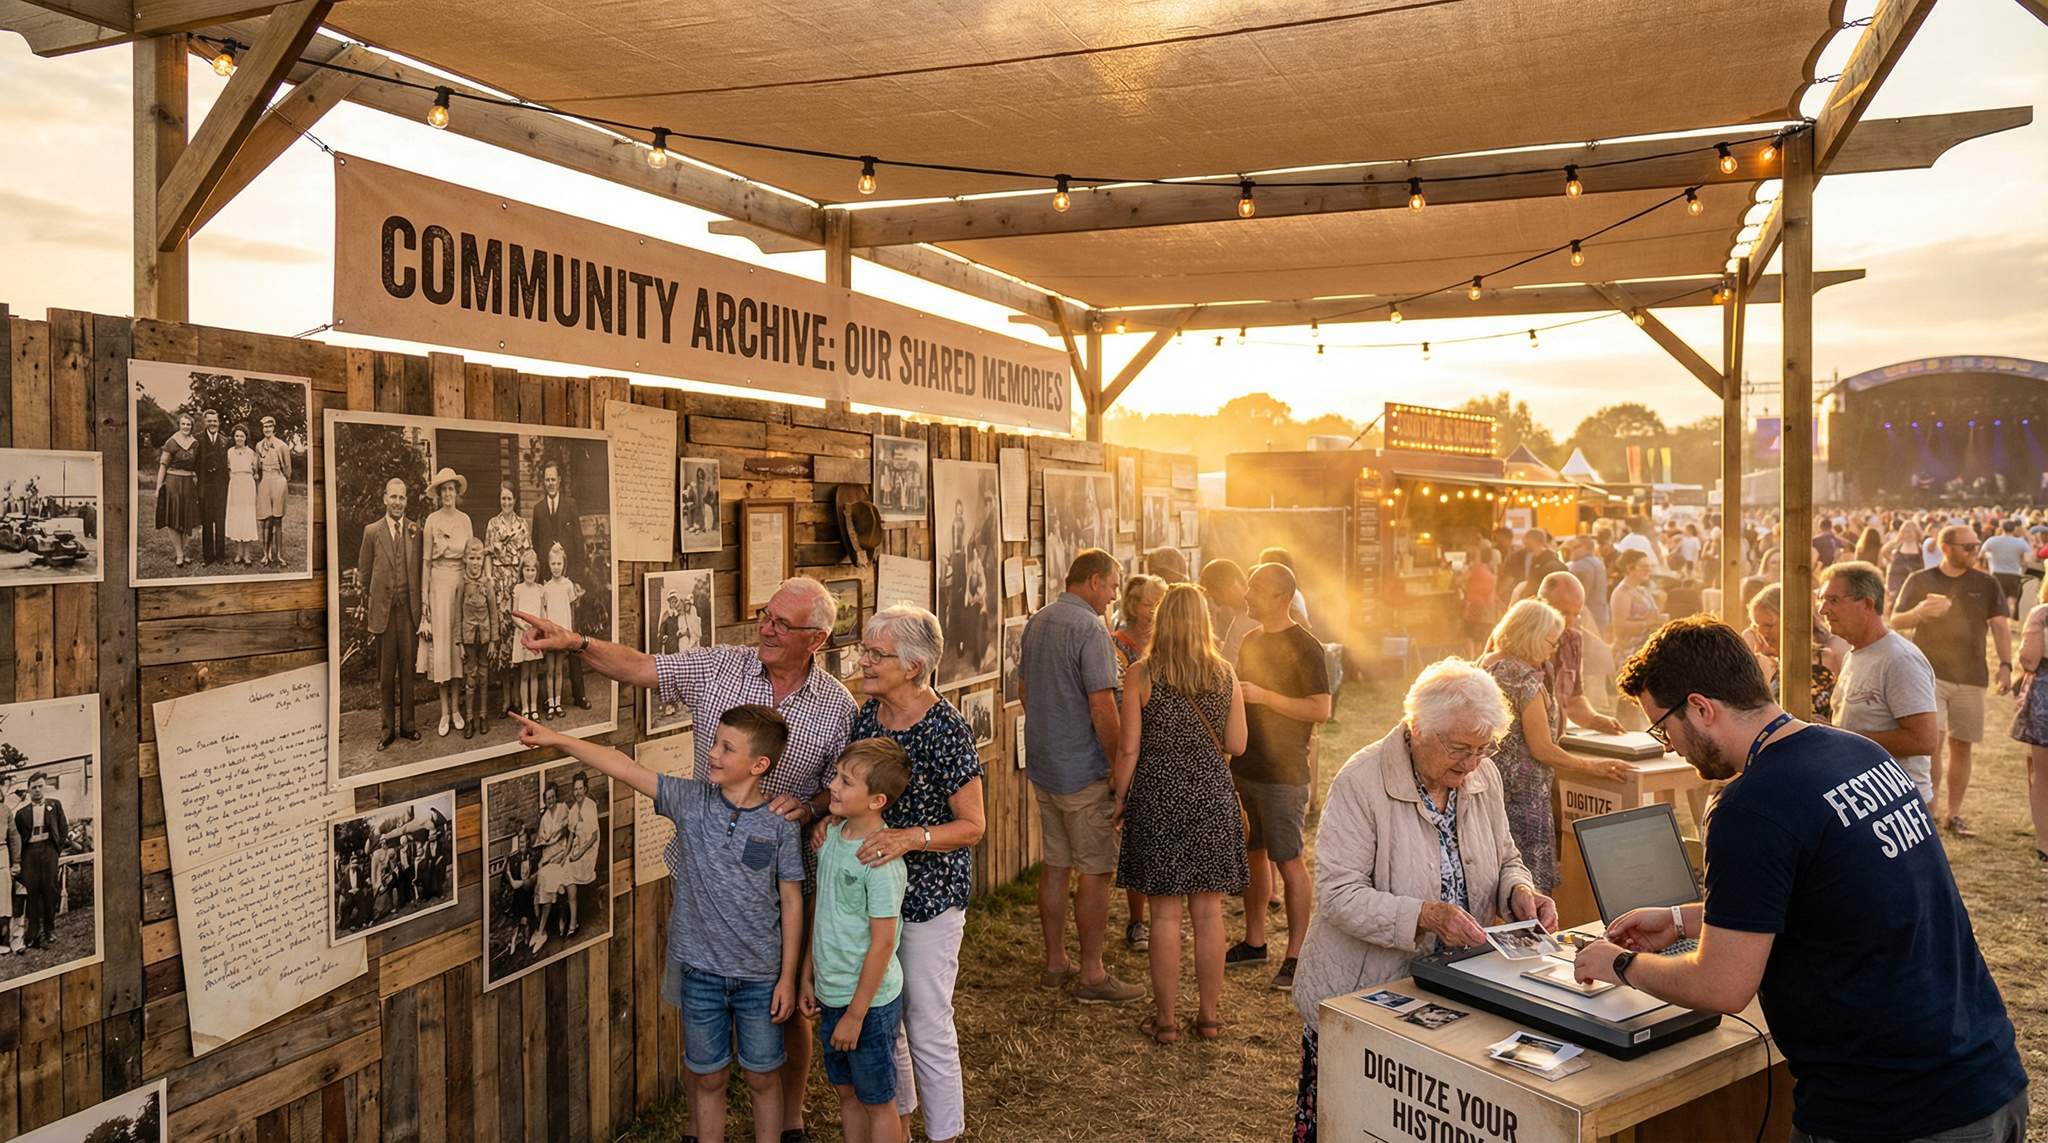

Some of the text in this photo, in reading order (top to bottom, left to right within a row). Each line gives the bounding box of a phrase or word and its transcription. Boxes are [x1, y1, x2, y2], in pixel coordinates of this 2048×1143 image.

[381, 215, 1063, 412] COMMUNITY ARCHIVE: OUR SHARED MEMORIES
[1566, 790, 1613, 815] DIGITIZE
[1822, 758, 1916, 828] FESTIVAL
[1872, 798, 1932, 859] STAFF
[1364, 1047, 1518, 1143] DIGITIZE YOUR
